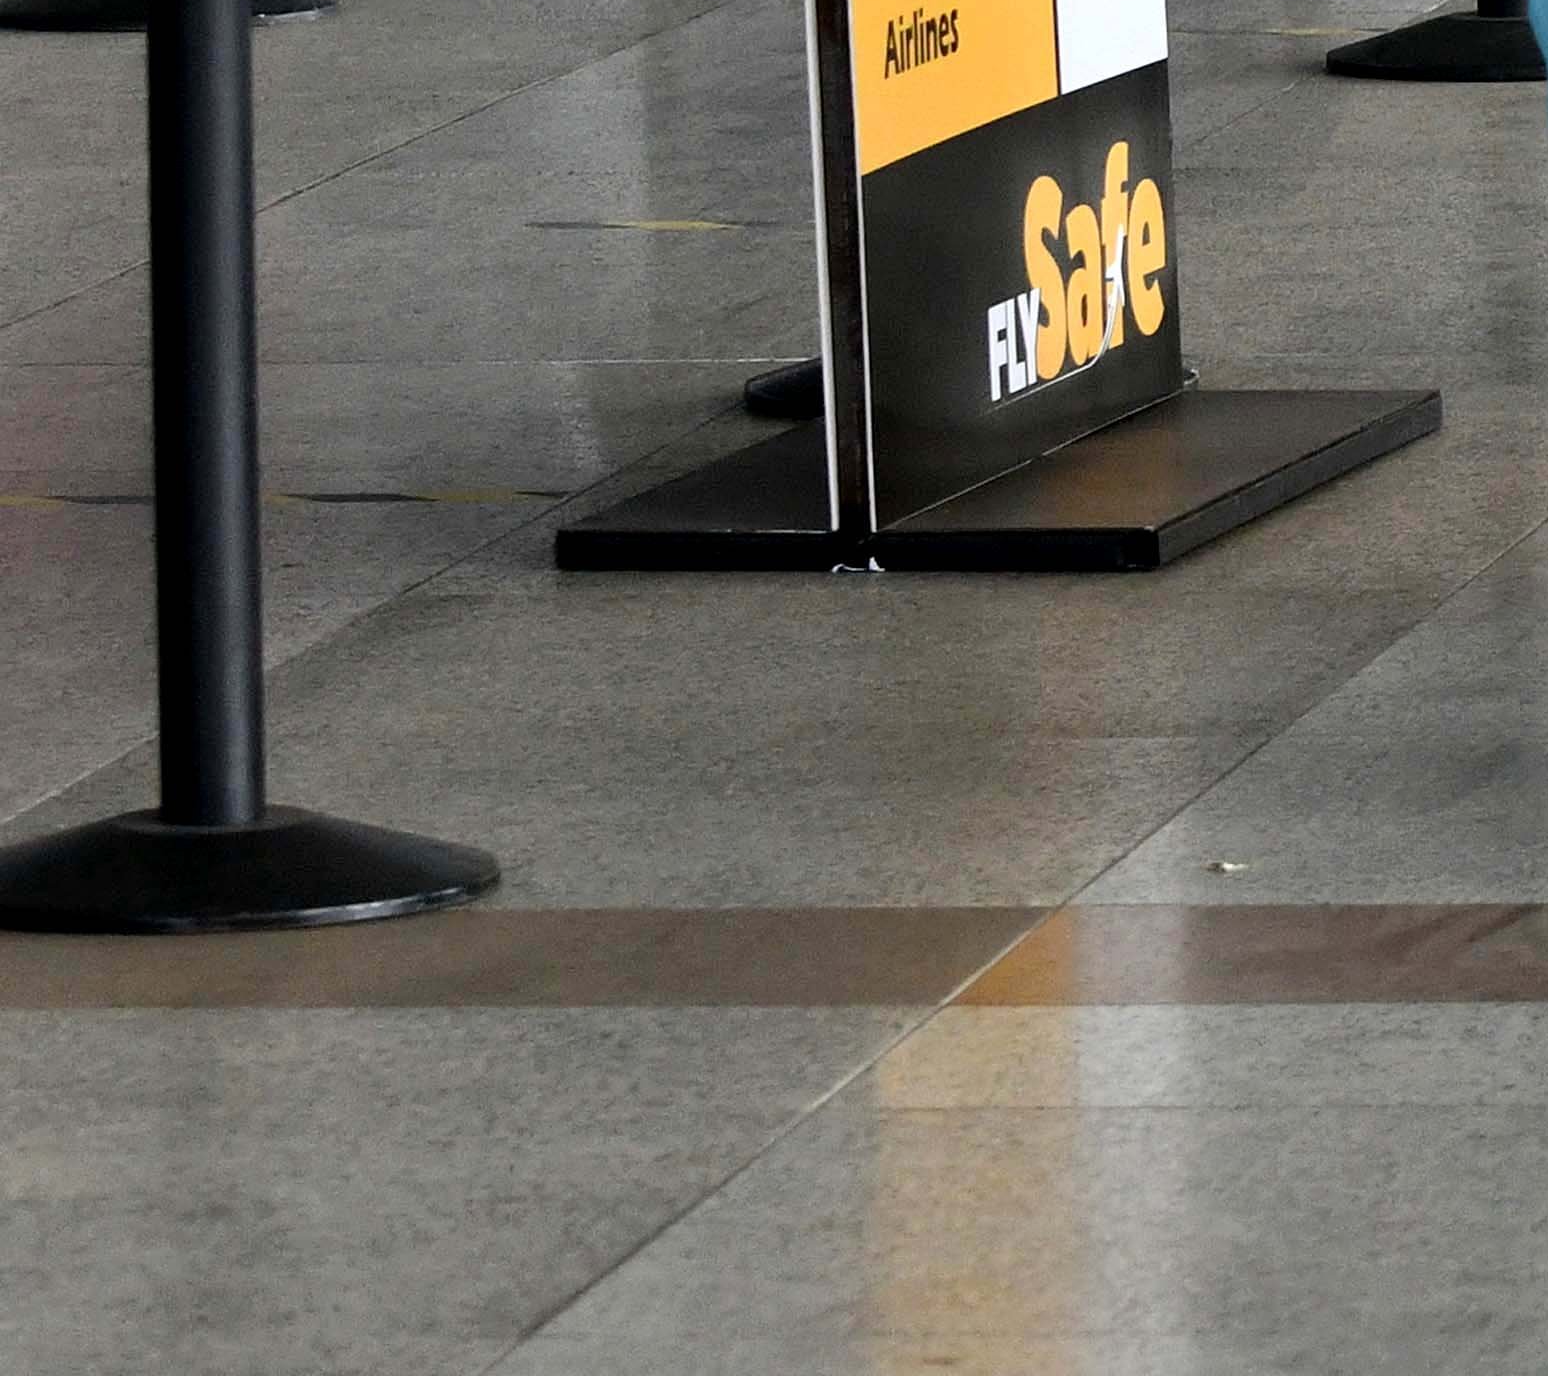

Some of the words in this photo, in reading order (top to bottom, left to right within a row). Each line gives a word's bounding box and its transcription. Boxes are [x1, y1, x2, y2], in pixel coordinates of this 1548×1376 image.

[884, 6, 960, 80] Airlines
[987, 286, 1042, 402] FLY
[1024, 140, 1167, 381] Safe
